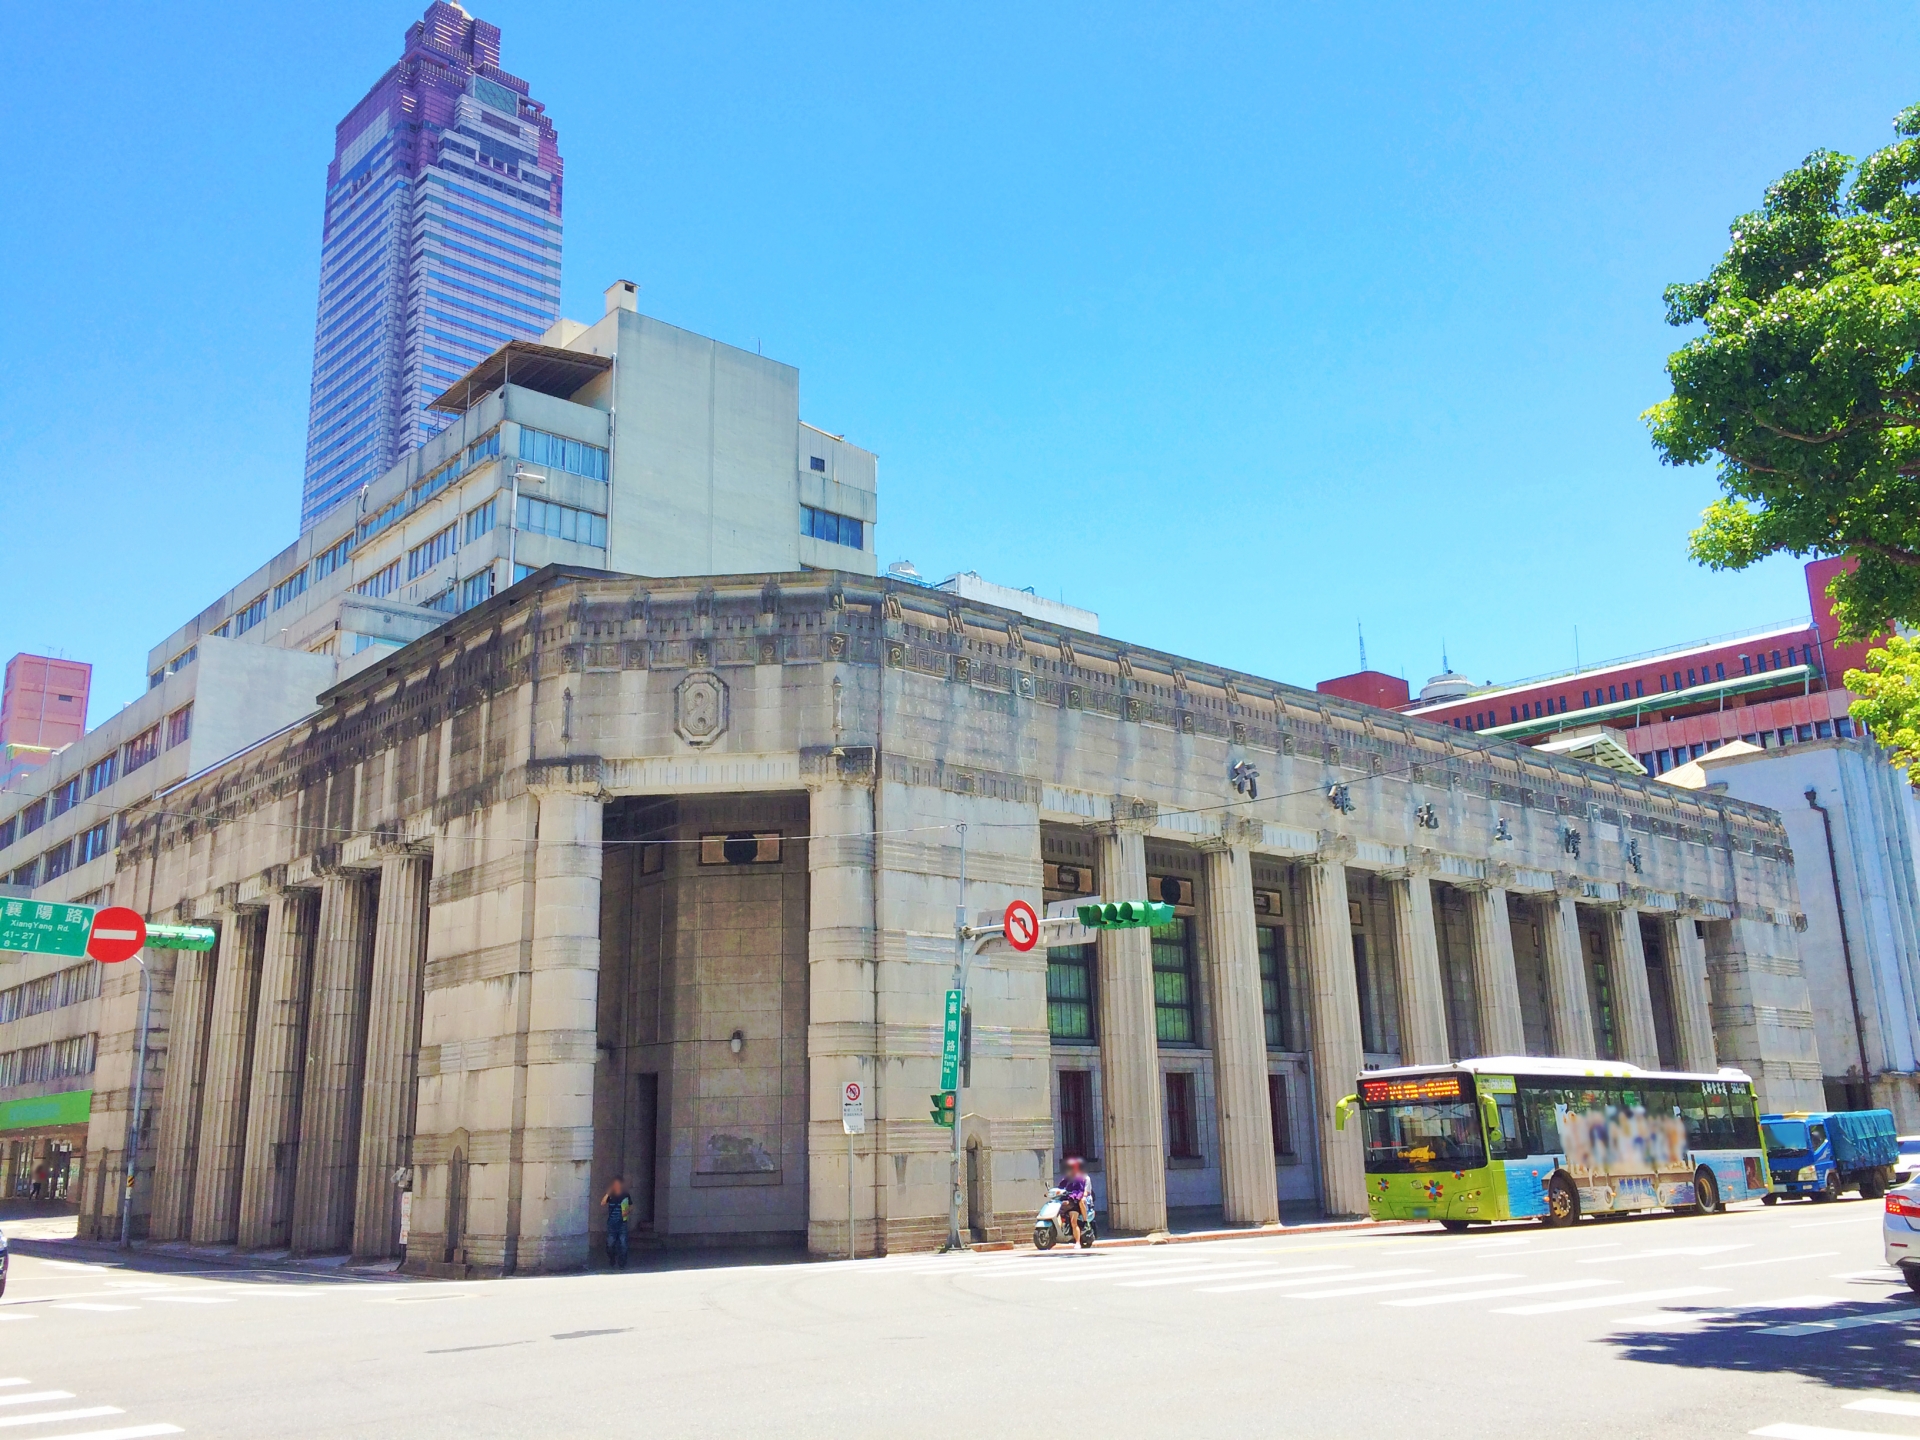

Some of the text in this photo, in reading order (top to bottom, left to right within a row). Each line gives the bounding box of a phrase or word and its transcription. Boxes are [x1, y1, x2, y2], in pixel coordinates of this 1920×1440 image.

[5, 901, 83, 924] 襄陽路
[10, 919, 70, 932] XiangYang Rd.
[946, 1002, 957, 1052] 襄陽路
